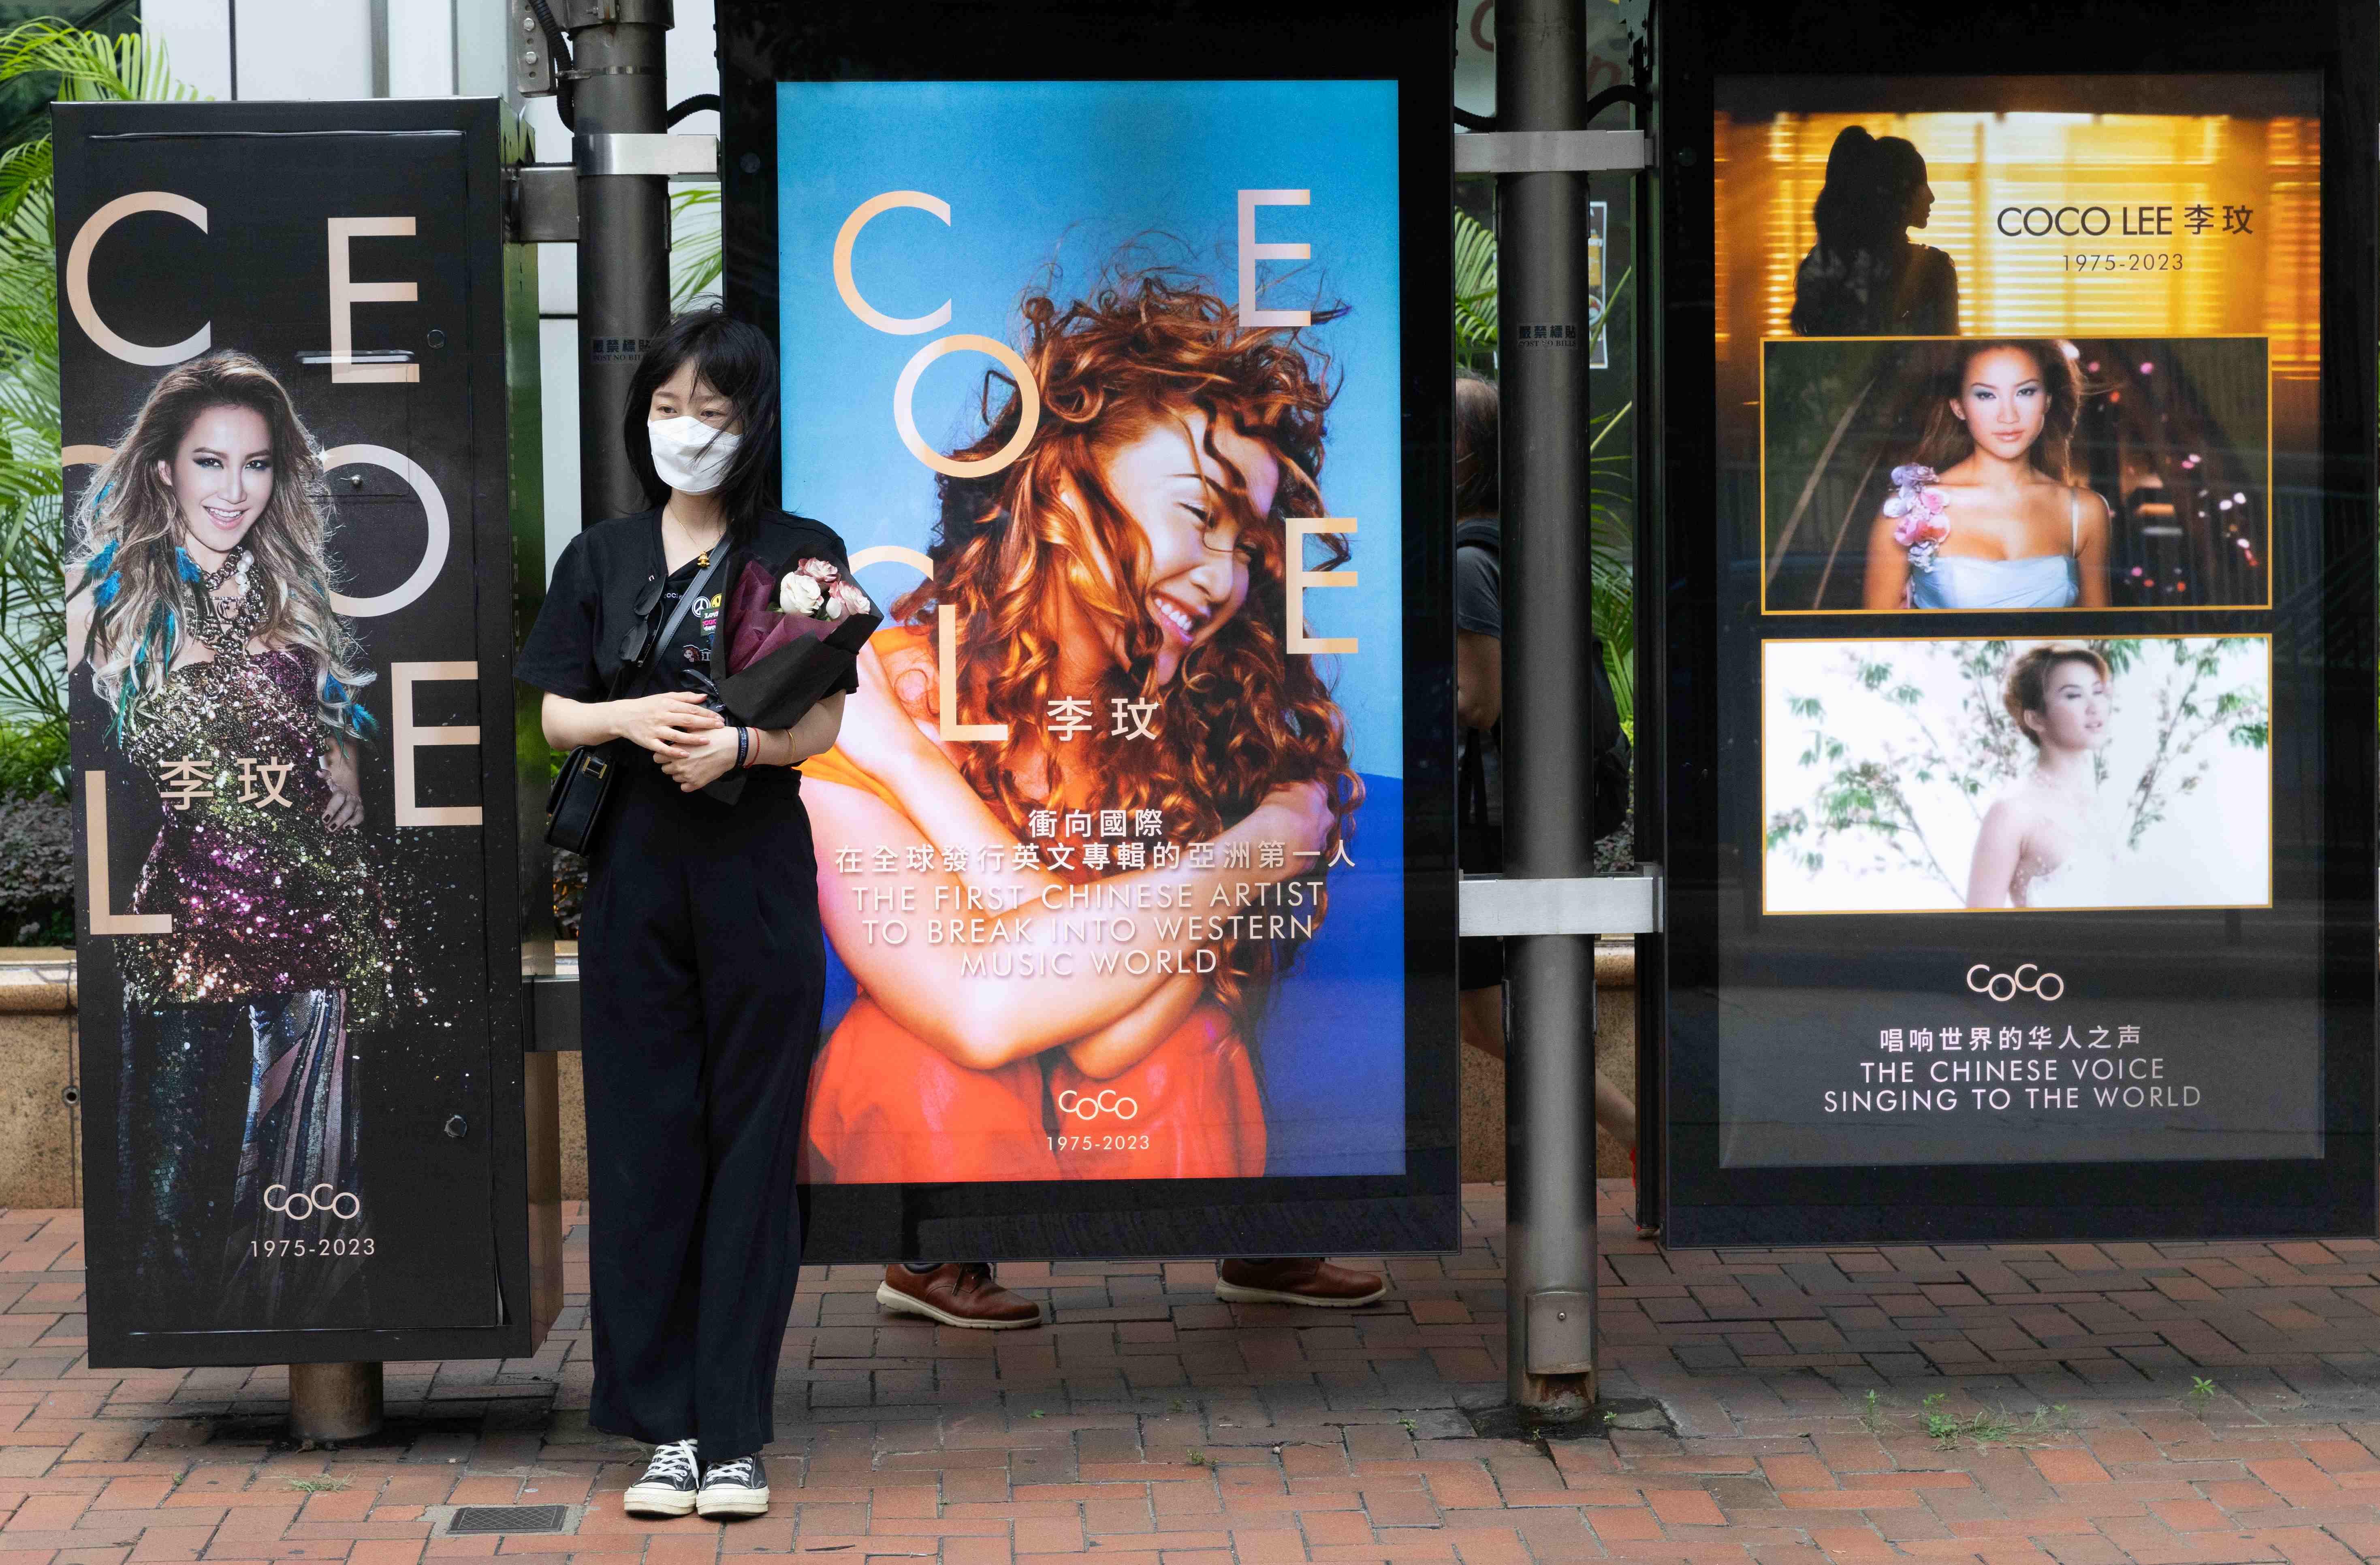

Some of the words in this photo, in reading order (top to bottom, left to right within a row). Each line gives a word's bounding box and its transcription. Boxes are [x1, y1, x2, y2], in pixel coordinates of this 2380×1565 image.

[1998, 207, 2110, 236] COCO
[2123, 207, 2172, 235] LEE
[2184, 205, 2253, 235] 李玟
[833, 190, 952, 335] C
[1238, 190, 1311, 326] E
[2063, 254, 2183, 271] 1975-2023
[66, 192, 211, 366] C
[329, 217, 420, 383] E
[894, 334, 1040, 478] O
[1286, 518, 1358, 654] E
[939, 605, 1008, 741] L
[1047, 696, 1159, 741] 李玟
[391, 661, 482, 827] E
[159, 756, 295, 810] 李玟
[1029, 808, 1162, 838] 衝向國際
[85, 770, 173, 935] L
[836, 840, 1355, 873] 在全球發行英文專輯的亞洲第一人
[852, 886, 915, 911] THE
[935, 885, 1024, 910] FIRST
[1042, 883, 1192, 910] CHINESE
[1210, 882, 1323, 907] ARTIST
[862, 919, 907, 944] TO
[928, 918, 1034, 943] BREAK
[1052, 917, 1136, 942] INTO
[1154, 915, 1311, 940] WESTERN
[961, 952, 1073, 976] MUSIC
[1090, 949, 1216, 975] WORLD
[1880, 1025, 2141, 1053] 唱响世界的华人之声
[1860, 1062, 1913, 1083] THE
[1930, 1060, 2057, 1082] CHINESE
[2071, 1058, 2163, 1080] VOICE
[1824, 1089, 1957, 1113] SINGING
[1972, 1088, 2011, 1110] TO
[2025, 1087, 2079, 1109] THE
[2093, 1086, 2200, 1108] WORLD
[1047, 1135, 1149, 1150] 1975-2023
[250, 1238, 375, 1257] 1975-2023
